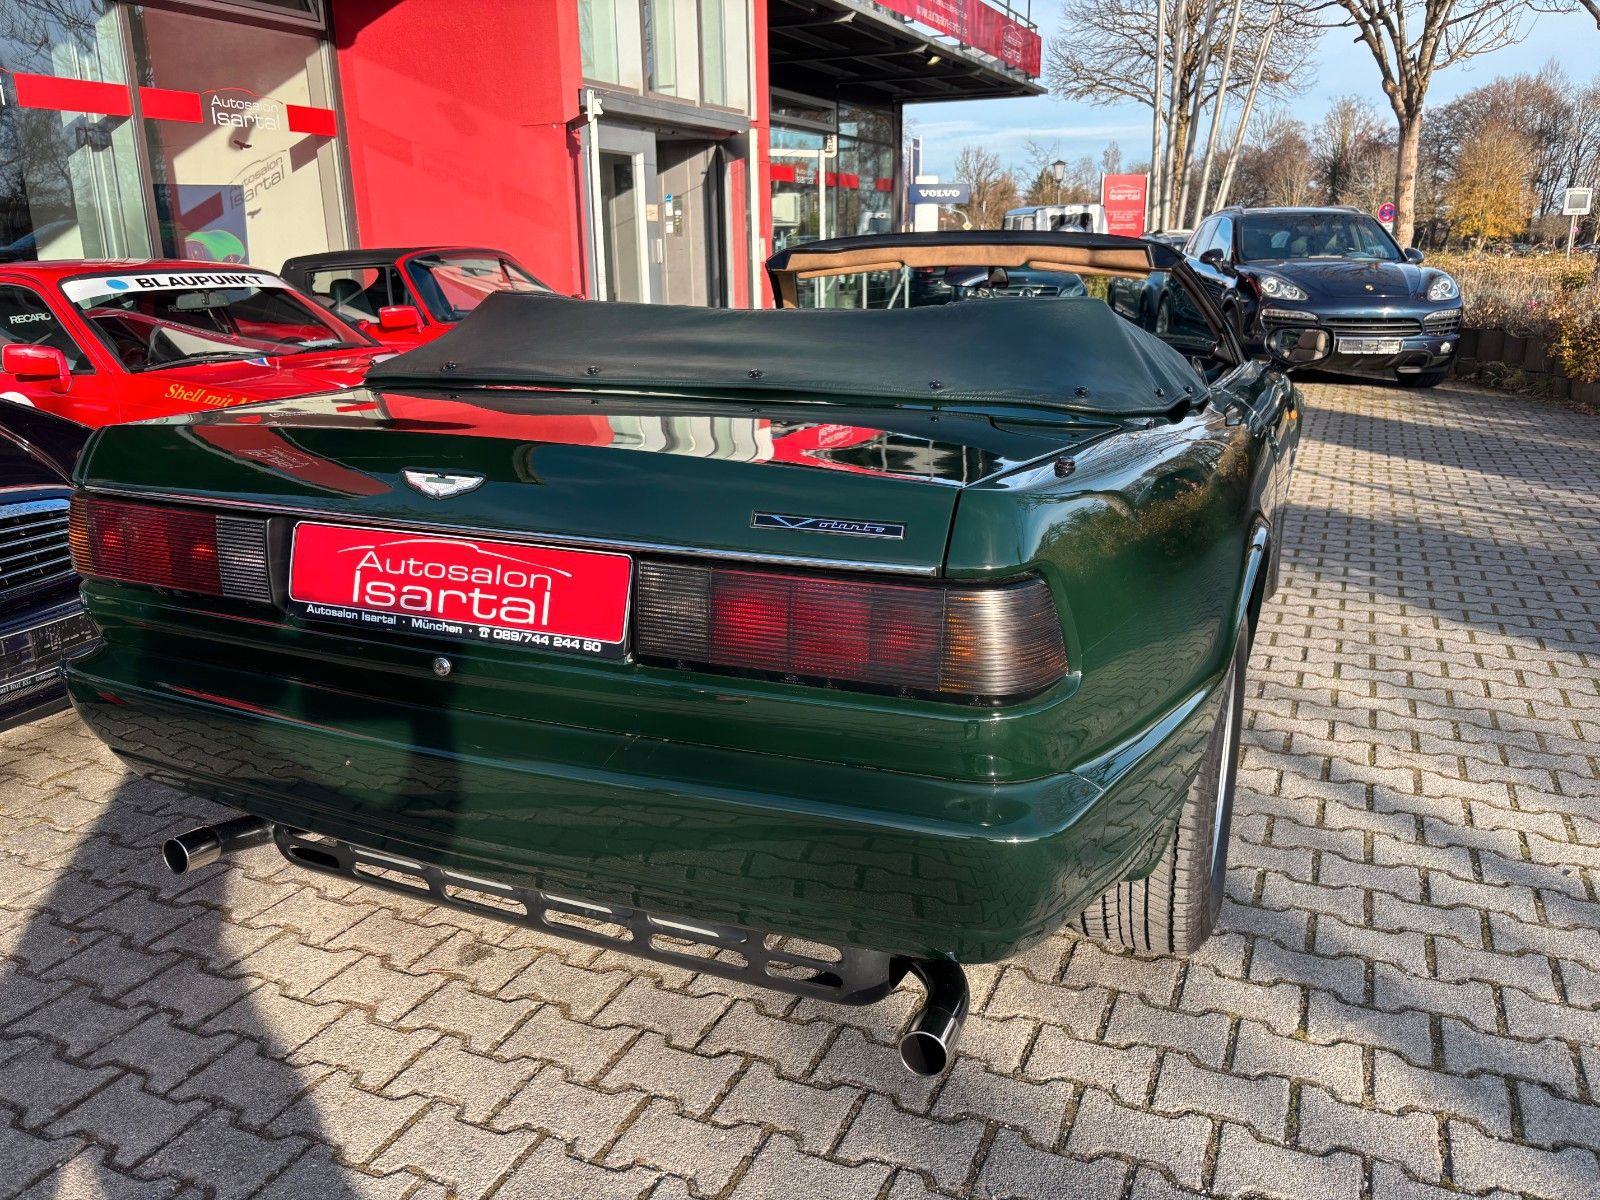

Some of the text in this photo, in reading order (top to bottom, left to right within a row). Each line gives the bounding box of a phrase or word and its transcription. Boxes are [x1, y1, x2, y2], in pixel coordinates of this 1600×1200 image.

[211, 93, 279, 113] Autosalon
[211, 106, 281, 131] Isartal
[918, 188, 961, 198] VOLVO
[136, 274, 265, 290] BLAUPUNKT
[9, 312, 52, 325] RECARO
[165, 383, 206, 403] Shell
[203, 394, 234, 408] mit
[355, 550, 552, 591] Autosalon
[352, 570, 550, 626] Isartal
[306, 604, 602, 652] Autosalon Isartal München 089/744 244 60
